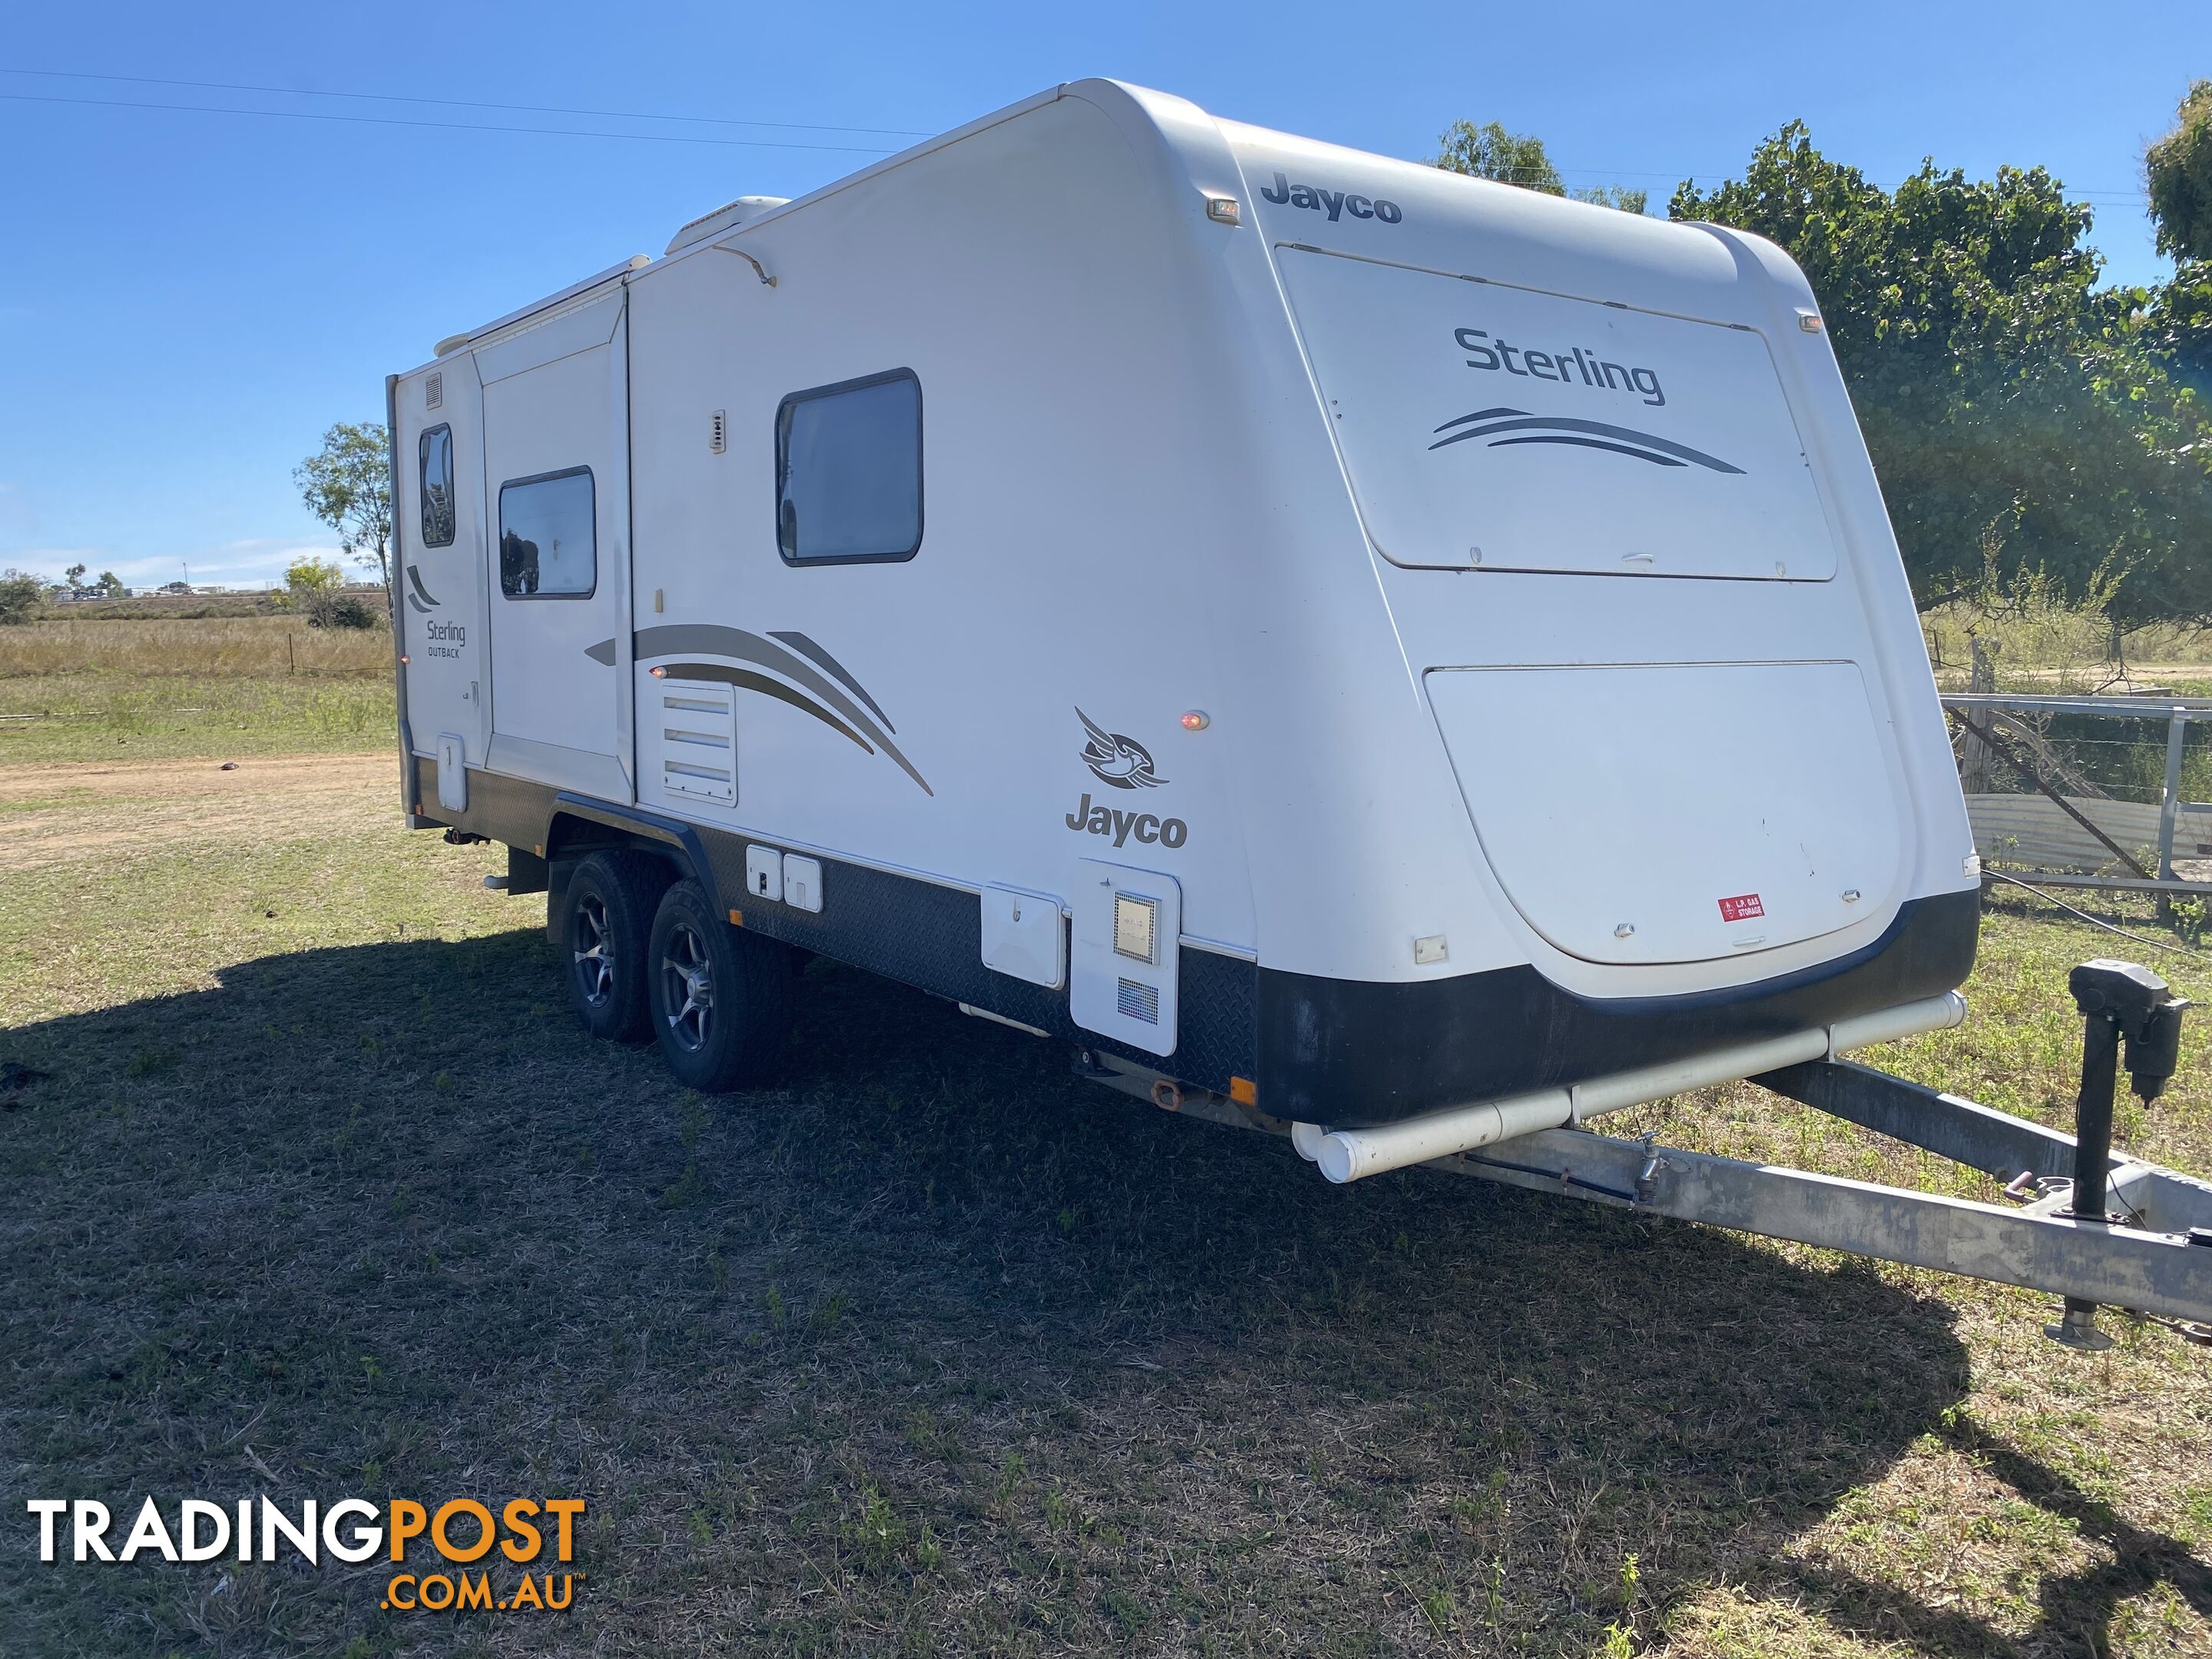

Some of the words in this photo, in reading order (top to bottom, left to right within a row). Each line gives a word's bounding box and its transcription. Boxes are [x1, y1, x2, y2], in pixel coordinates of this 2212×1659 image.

[1260, 172, 1402, 224] Jayco
[1454, 327, 1666, 407] Sterling
[427, 620, 465, 647] Sterling
[428, 647, 460, 659] OUTBACK
[1065, 793, 1187, 849] Jayco
[1738, 906, 1762, 916] STORAGE
[1747, 897, 1759, 906] GAS
